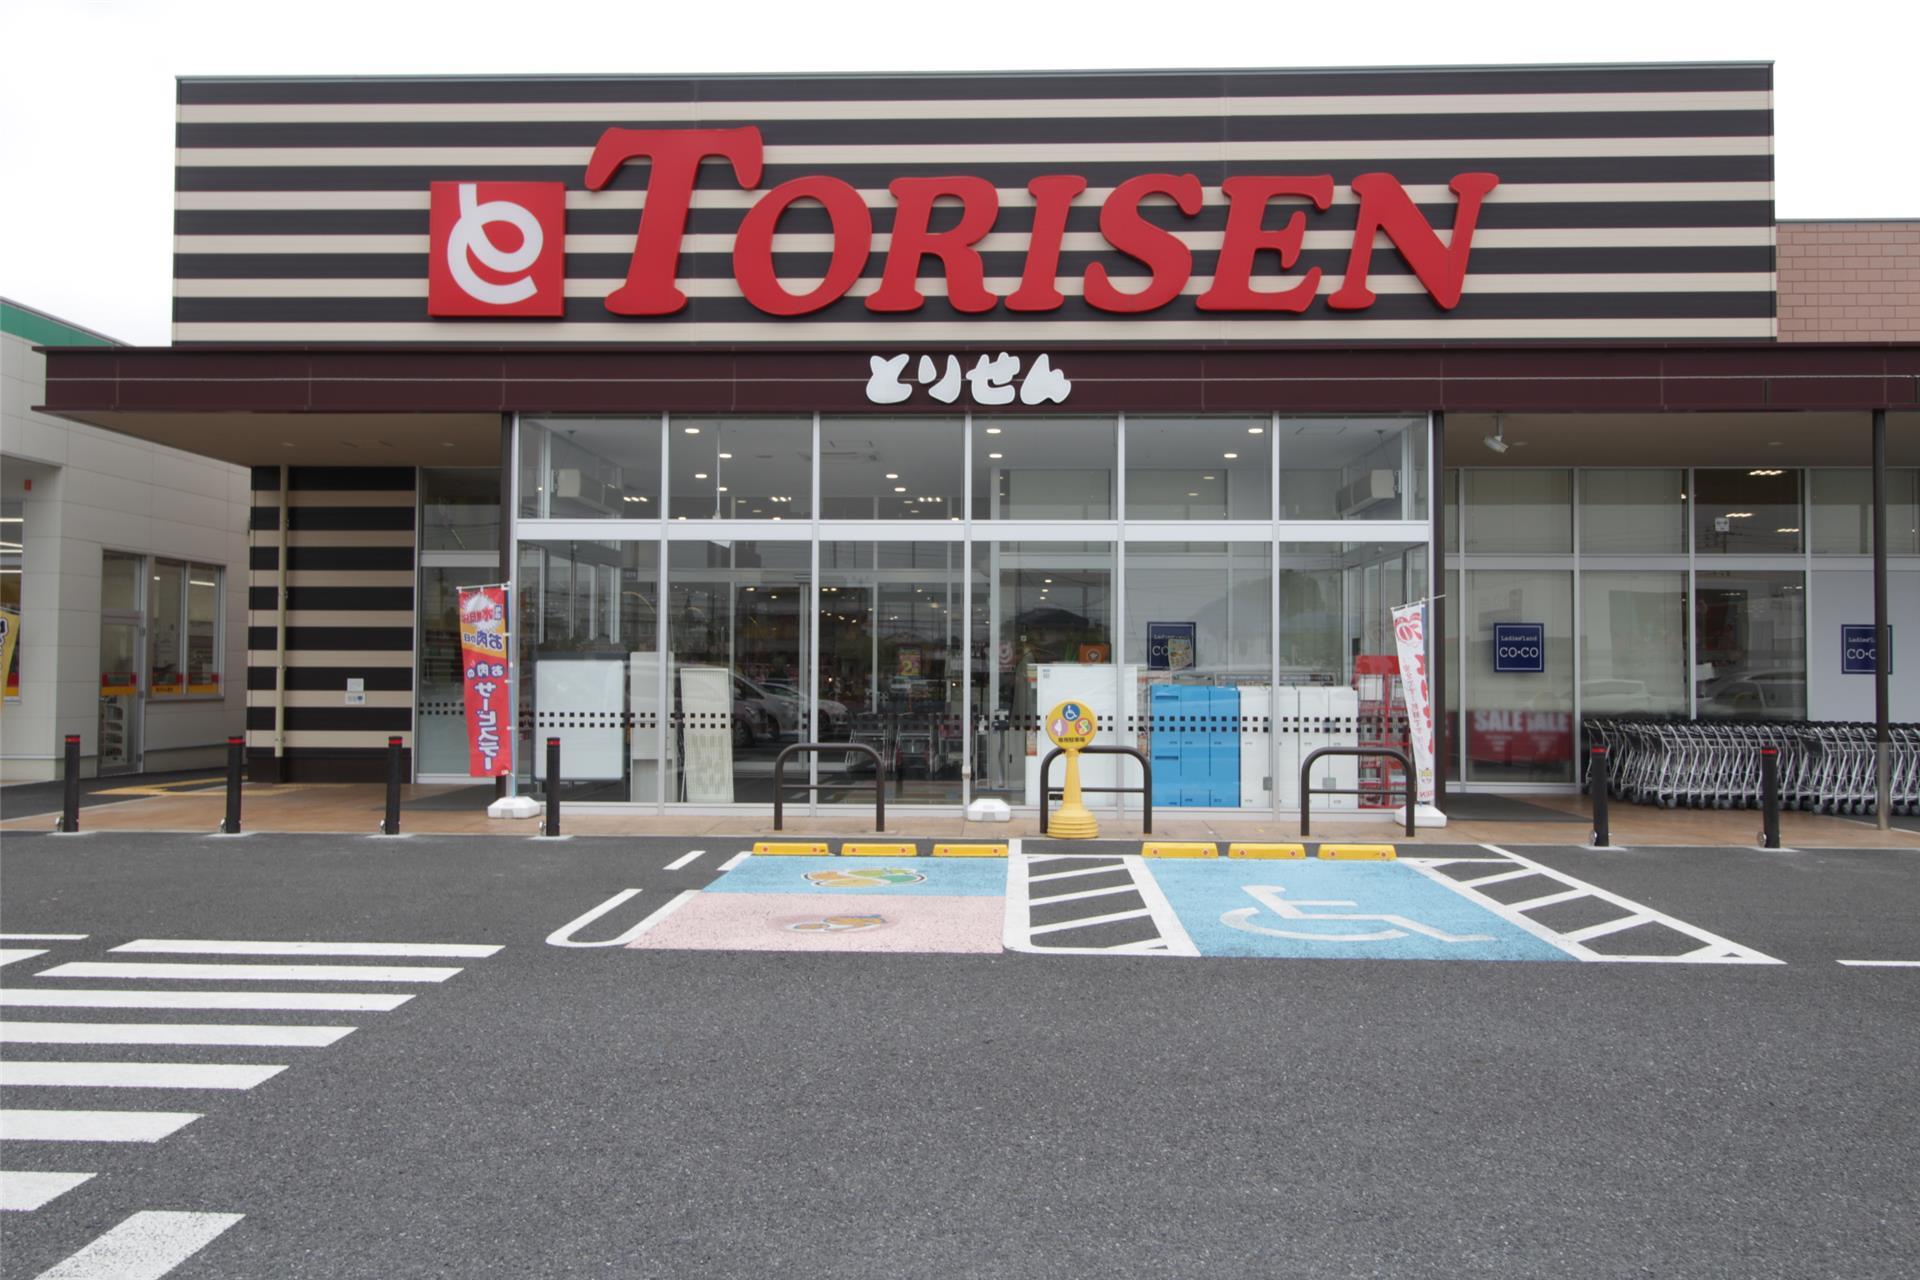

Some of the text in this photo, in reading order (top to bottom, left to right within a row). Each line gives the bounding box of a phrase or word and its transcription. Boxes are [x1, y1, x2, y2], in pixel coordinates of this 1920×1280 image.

[584, 126, 1500, 316] TORISEN
[866, 352, 1072, 405] とりせん
